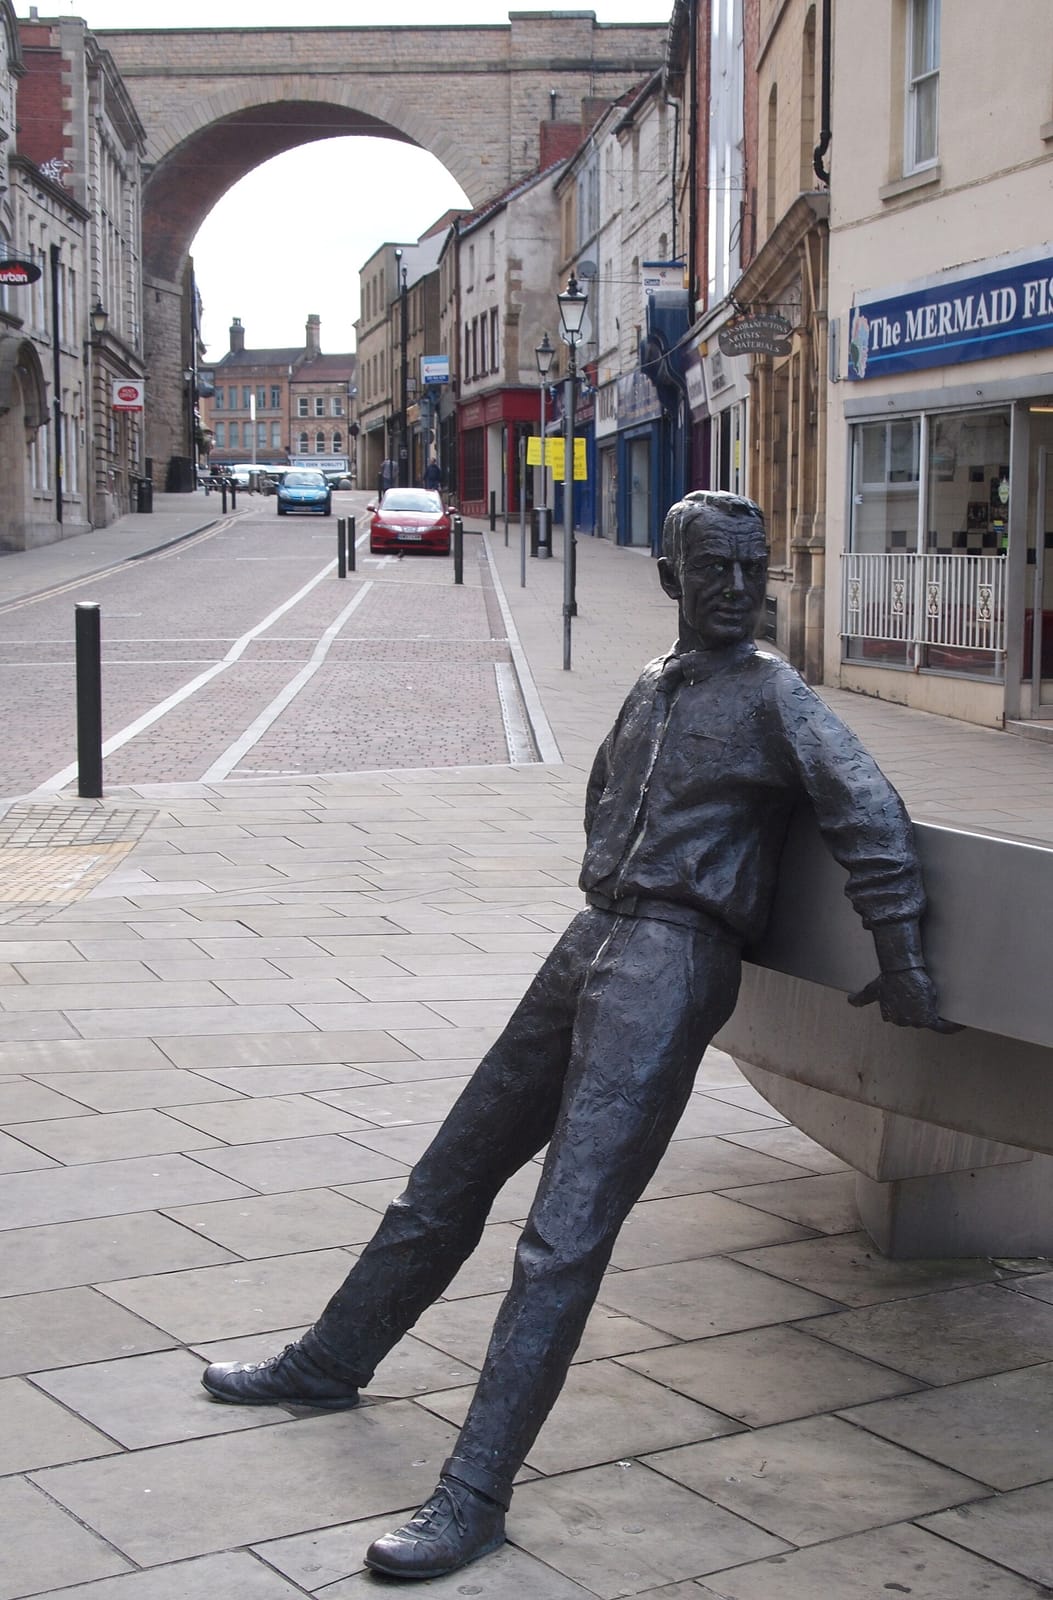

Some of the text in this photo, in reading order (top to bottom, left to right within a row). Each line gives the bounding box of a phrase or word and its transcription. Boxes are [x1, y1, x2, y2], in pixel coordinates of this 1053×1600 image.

[0, 271, 28, 282] urban
[869, 316, 902, 351] The
[904, 286, 1018, 344] MERMAID
[734, 341, 781, 353] MATERIALS
